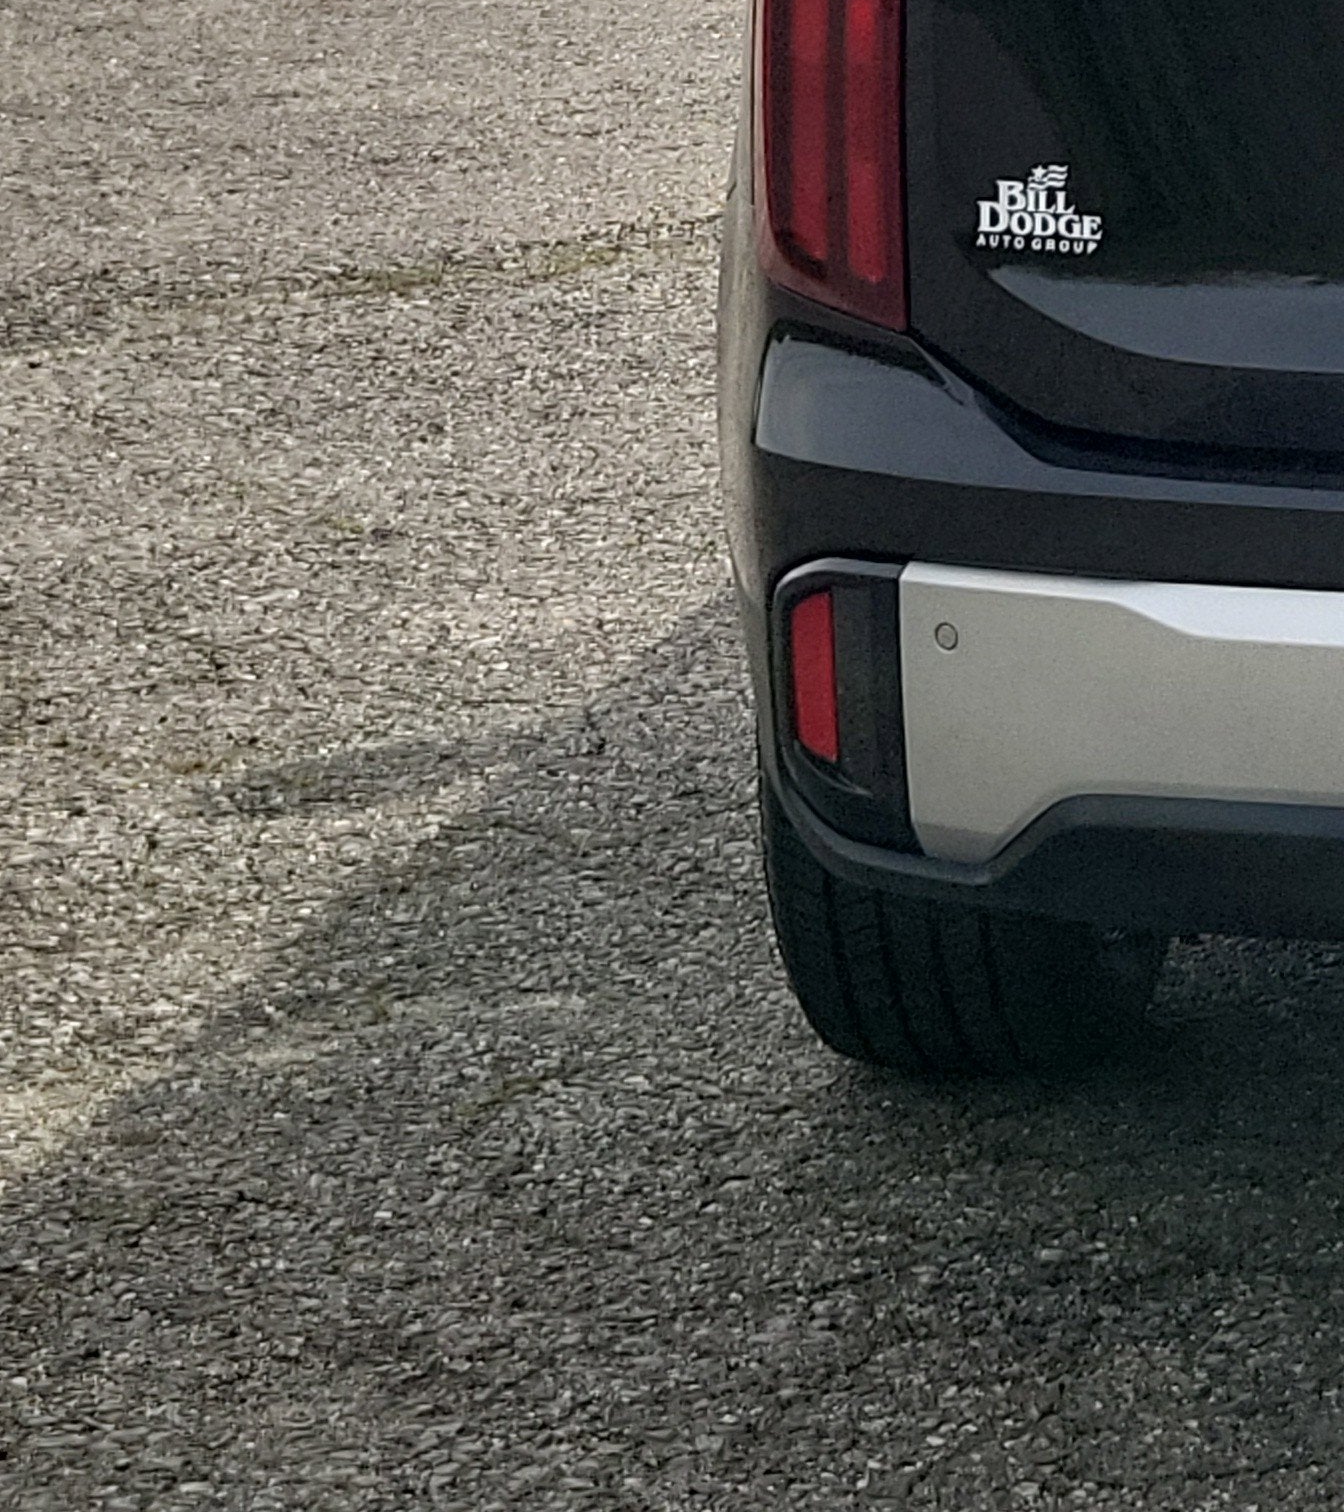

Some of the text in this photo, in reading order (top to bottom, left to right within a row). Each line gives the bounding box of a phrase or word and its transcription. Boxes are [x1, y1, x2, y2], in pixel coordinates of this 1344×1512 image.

[996, 179, 1075, 215] BILL
[976, 200, 1103, 240] DODGE
[976, 234, 1098, 255] AUTO GROUP
